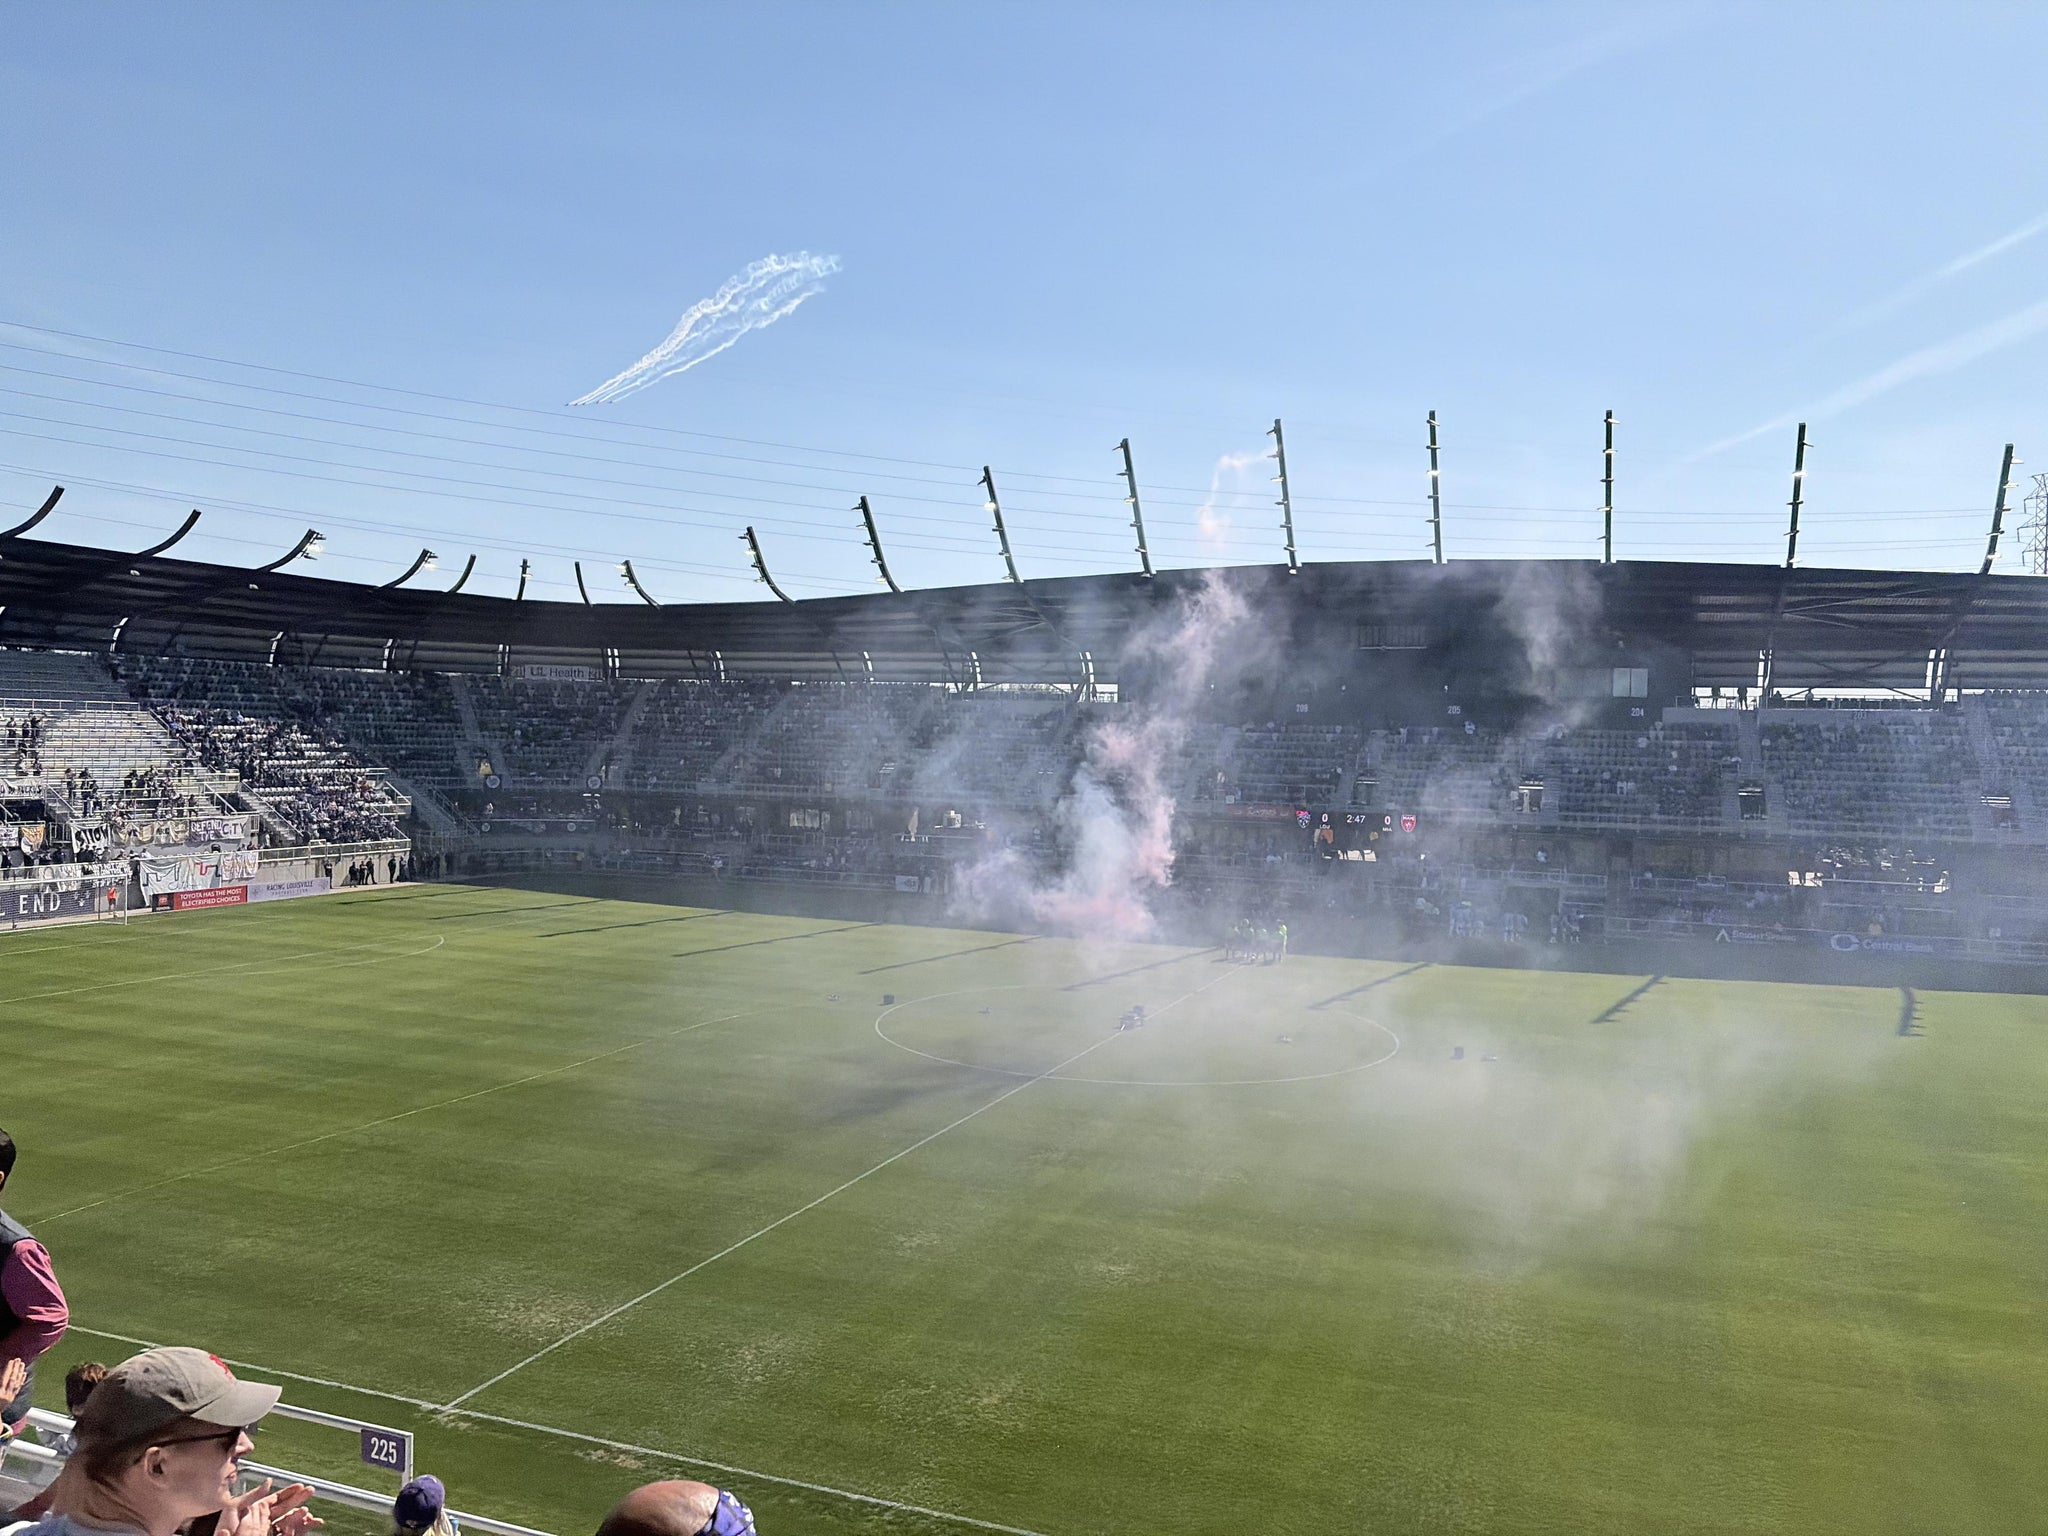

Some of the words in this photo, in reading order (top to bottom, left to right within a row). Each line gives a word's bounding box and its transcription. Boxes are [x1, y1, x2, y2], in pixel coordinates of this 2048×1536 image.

[549, 667, 584, 678] Health
[1447, 705, 1461, 715] 205
[1631, 707, 1644, 717] 204
[1321, 813, 1329, 823] 0
[1346, 814, 1366, 824] 2:47
[1384, 815, 1391, 826] 0
[266, 883, 286, 891] RACING
[286, 880, 313, 890] LOUISVILLE
[180, 892, 202, 900] TOYOTA
[202, 890, 215, 898] HAS
[215, 889, 226, 897] THE
[226, 887, 242, 895] MOST
[19, 892, 61, 915] END
[181, 898, 215, 908] ELECTRIFIED
[216, 895, 241, 903] CHOICES
[1862, 939, 1903, 952] Central
[370, 1436, 398, 1464] 225
